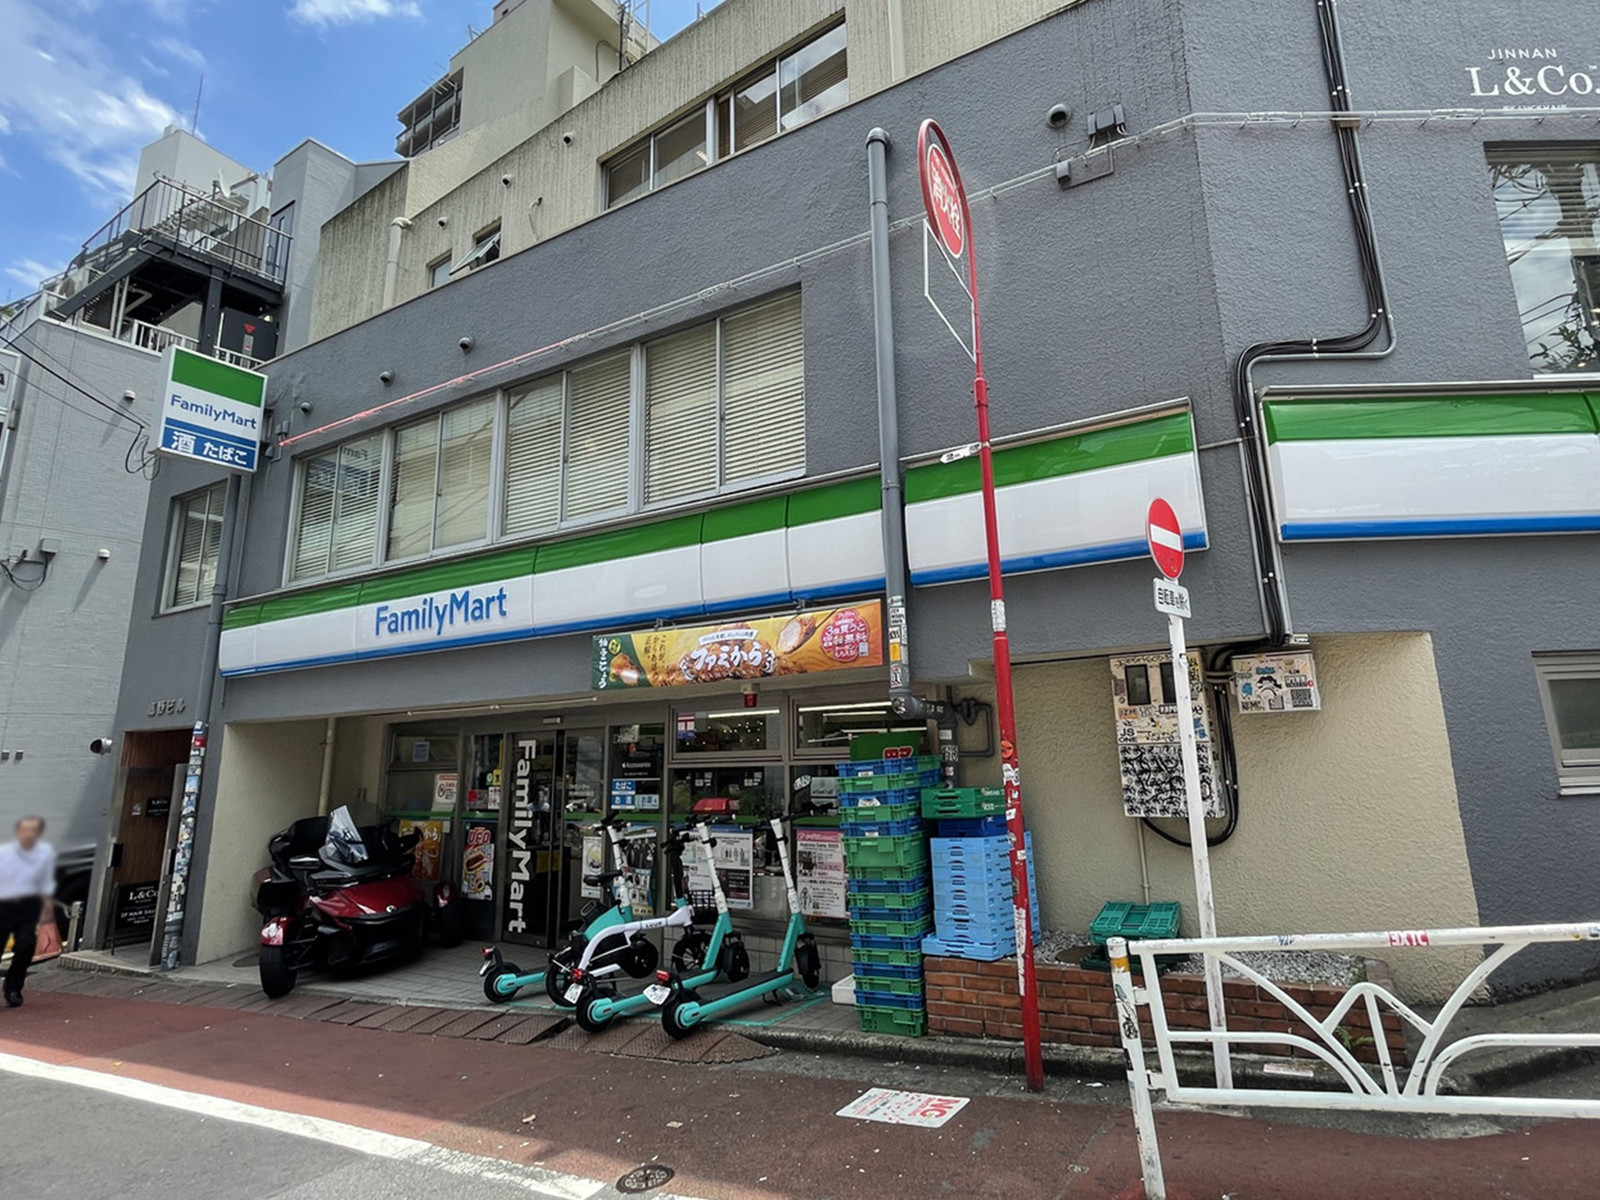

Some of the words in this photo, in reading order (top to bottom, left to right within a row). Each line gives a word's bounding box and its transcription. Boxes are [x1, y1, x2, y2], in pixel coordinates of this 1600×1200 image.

[1487, 48, 1558, 60] JINNAN
[170, 394, 258, 429] FamilyMart
[170, 431, 197, 455] 酒
[203, 441, 247, 465] たばこ
[375, 586, 507, 636] FamilyMart
[690, 641, 763, 671] ファミから
[615, 781, 633, 790] たばこ
[508, 739, 536, 934] FamilyMart
